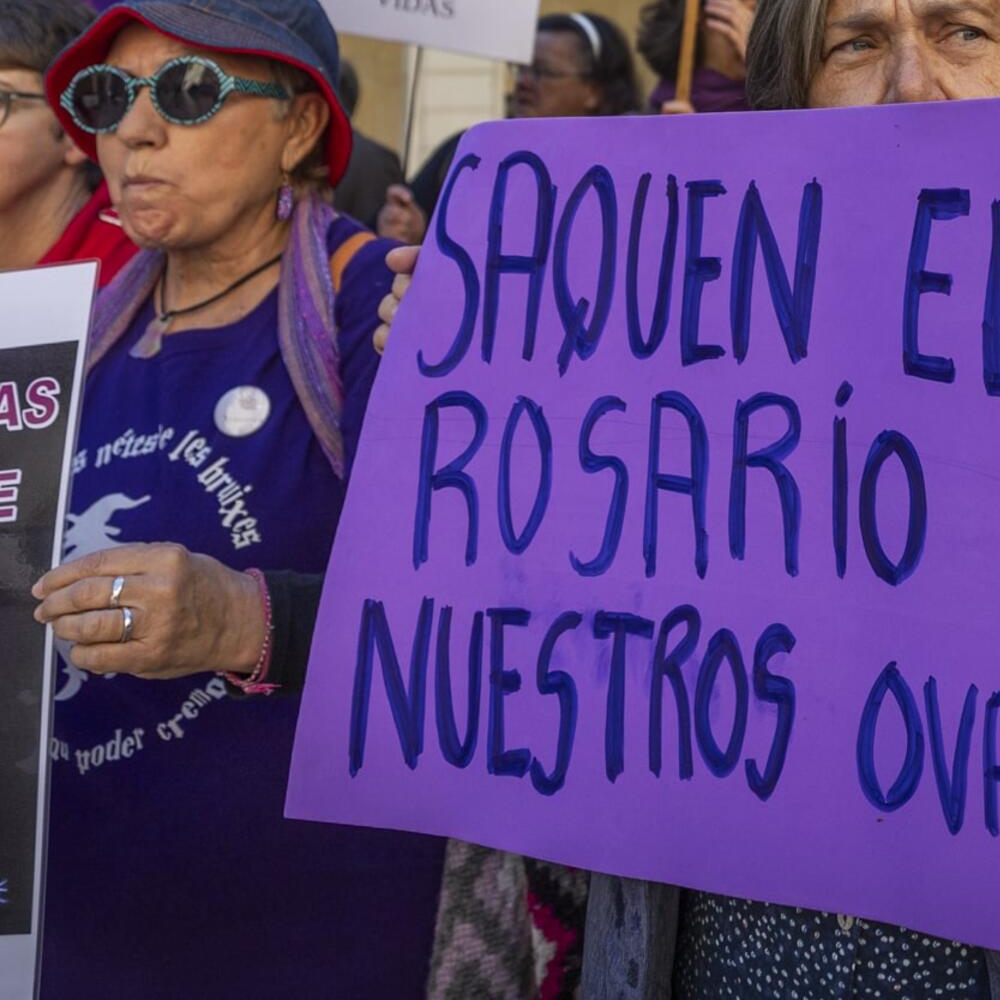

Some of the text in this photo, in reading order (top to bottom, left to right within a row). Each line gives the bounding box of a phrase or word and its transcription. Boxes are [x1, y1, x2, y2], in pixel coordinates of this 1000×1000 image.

[417, 151, 822, 377] SAQUEN
[0, 376, 61, 430] AS
[168, 429, 212, 468] les
[197, 456, 262, 550] bruixes
[75, 728, 144, 774] poder
[349, 597, 796, 801] NUESTROS
